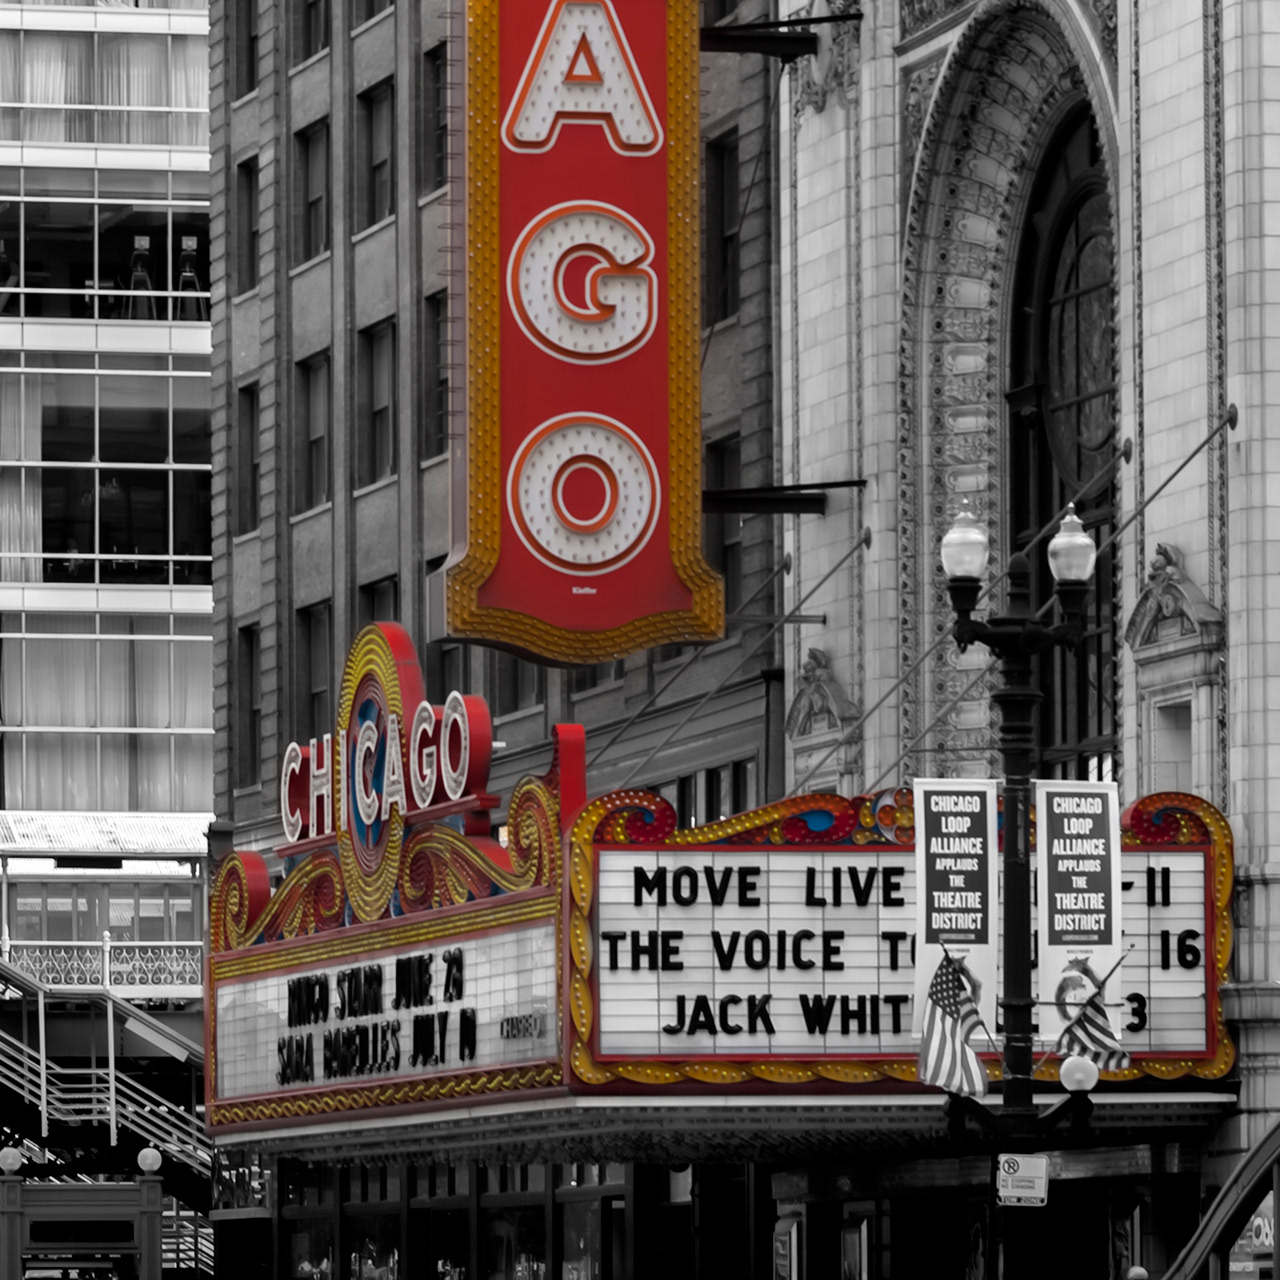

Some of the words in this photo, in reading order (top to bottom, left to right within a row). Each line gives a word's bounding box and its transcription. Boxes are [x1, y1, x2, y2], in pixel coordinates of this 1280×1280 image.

[280, 690, 470, 842] CHICAGO
[930, 796, 980, 812] CHICAGO
[1053, 797, 1102, 814] CHICAGO
[941, 817, 970, 833] LOOP
[1064, 818, 1093, 834] LOOP
[930, 838, 983, 853] ALLIANCE
[1053, 839, 1106, 855] ALLIANCE
[936, 859, 978, 870] APPLAUDS
[1058, 860, 1101, 872] APPLAUDS
[634, 866, 761, 907] MOVE
[805, 866, 905, 907] LIVE
[949, 875, 965, 887] THE
[1071, 876, 1087, 888] THE
[933, 892, 982, 908] THEATRE
[1055, 893, 1105, 909] THEATRE
[932, 913, 982, 929] DISTRICT
[1055, 914, 1106, 931] DISTRICT
[601, 930, 684, 971] THE
[711, 929, 845, 971] VOICE
[1161, 929, 1201, 969] 16
[662, 994, 776, 1035] JACK
[799, 994, 915, 1035] WHIT
